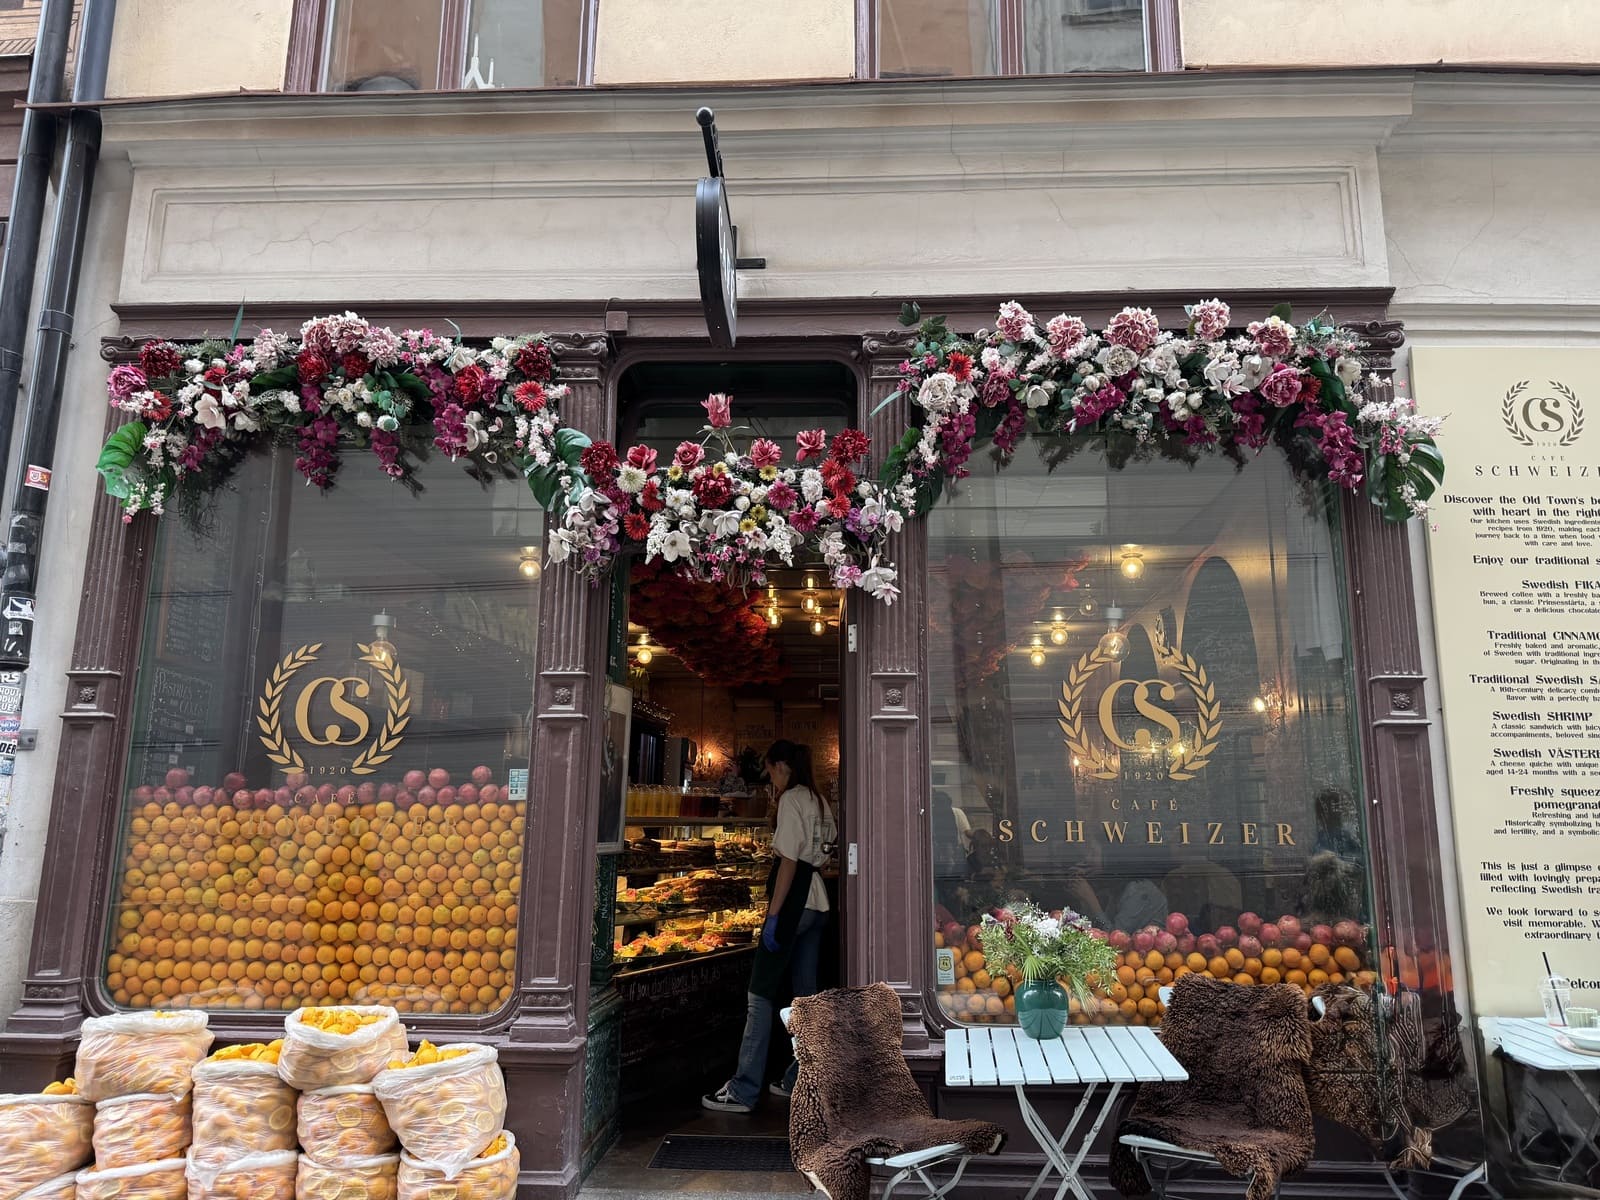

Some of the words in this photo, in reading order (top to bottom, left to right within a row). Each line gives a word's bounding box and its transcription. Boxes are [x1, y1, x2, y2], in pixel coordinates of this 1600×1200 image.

[1444, 495, 1493, 504] Discover
[1500, 495, 1516, 504] the
[1523, 495, 1540, 505] Old
[1547, 496, 1584, 505] Town's
[1473, 507, 1495, 516] with
[1502, 507, 1530, 516] heart
[1537, 508, 1546, 516] in
[1553, 508, 1569, 517] the
[1473, 555, 1503, 565] Enjoy
[1535, 556, 1589, 565] traditional
[1522, 580, 1568, 589] Swedish
[1487, 630, 1546, 640] Traditional
[1469, 674, 1529, 684] Traditional
[1536, 675, 1583, 684] Swedish
[1493, 711, 1540, 720] Swedish
[1548, 712, 1593, 721] SHRIMP
[1494, 748, 1541, 757] Swedish
[309, 765, 348, 775] 1920
[1124, 771, 1164, 781] 1920
[1511, 786, 1554, 797] Freshly
[1111, 798, 1178, 811] CAFÉ
[998, 819, 1297, 846] SCHWEIZER
[1481, 862, 1502, 870] This
[1507, 862, 1515, 870] is
[1521, 862, 1538, 871] just
[1555, 863, 1592, 872] glimpse
[1480, 873, 1503, 881] filled
[1508, 874, 1528, 882] with
[1534, 874, 1570, 883] lovingly
[1490, 885, 1536, 894] reflecting
[1542, 885, 1582, 894] Swedish
[1486, 907, 1502, 915] We
[1508, 907, 1528, 915] look
[1535, 908, 1573, 916] forward
[1503, 919, 1522, 927] visit
[1528, 919, 1586, 928] memorable.
[1525, 931, 1591, 941] extraordinary
[1564, 978, 1600, 989] elco
